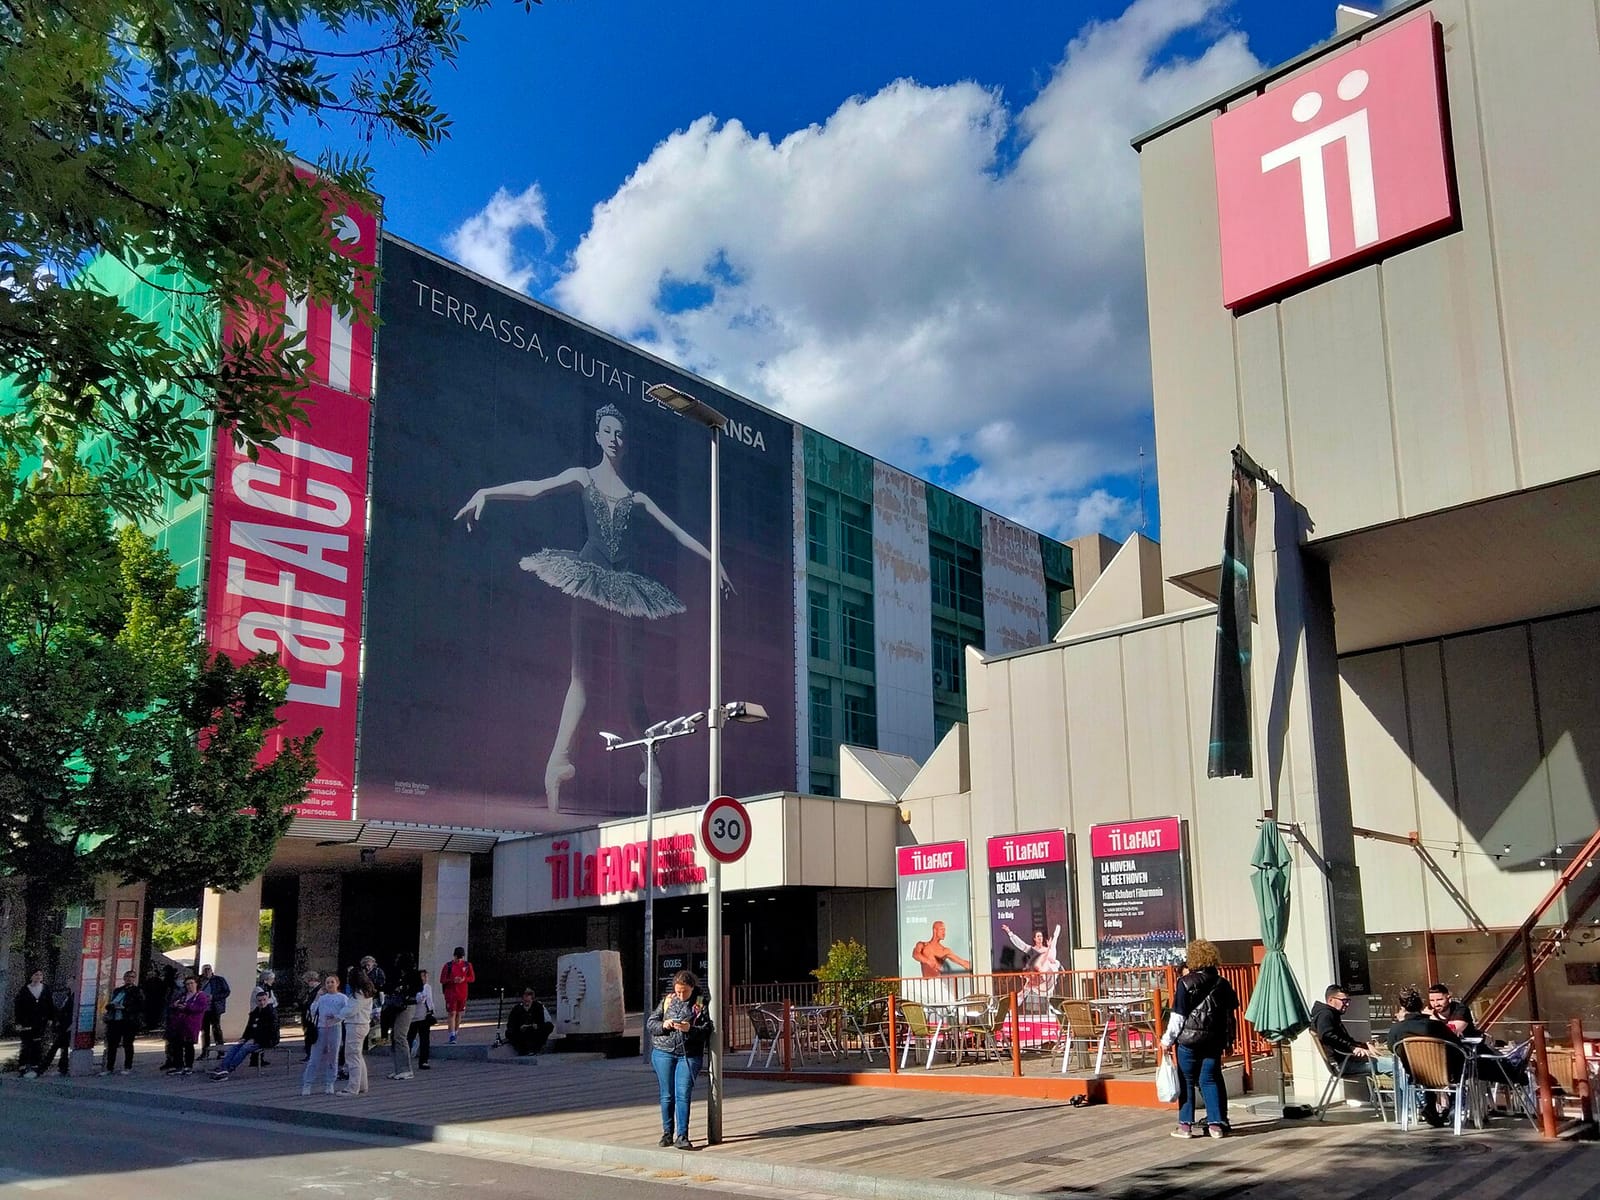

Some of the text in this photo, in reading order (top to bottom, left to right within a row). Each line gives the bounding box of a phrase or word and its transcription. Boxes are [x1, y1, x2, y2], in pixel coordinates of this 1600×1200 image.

[412, 280, 549, 363] TERRASSA,
[557, 345, 635, 394] CIUTAT
[713, 818, 741, 841] 30
[1123, 829, 1162, 851] LaFACT
[1016, 841, 1050, 861] LaFACT
[922, 852, 953, 870] LaFACT
[1101, 860, 1136, 874] LA NOVENA
[996, 868, 1046, 883] BALLET NACIONAL
[1102, 872, 1148, 887] DE BEETHOVEN
[905, 880, 928, 901] AILEY
[996, 882, 1021, 895] DE CUBA
